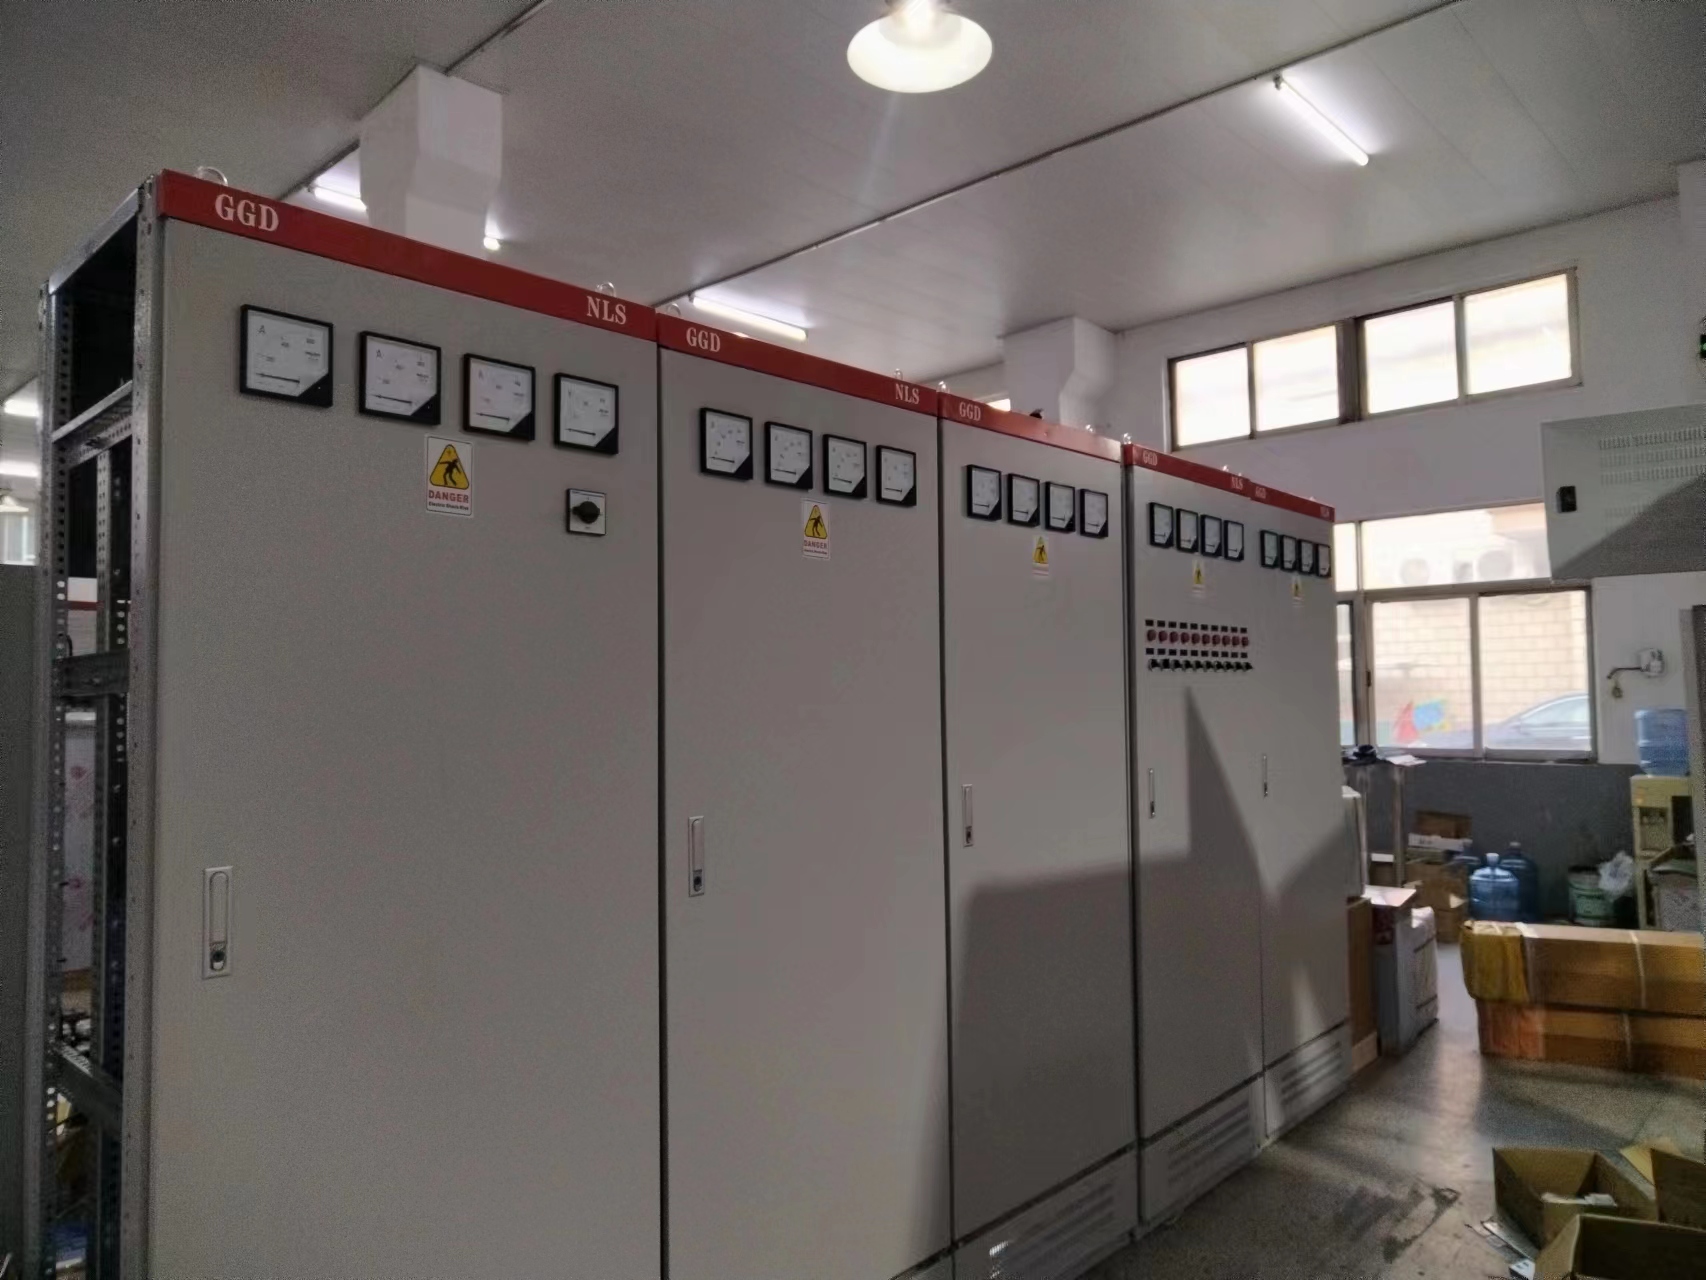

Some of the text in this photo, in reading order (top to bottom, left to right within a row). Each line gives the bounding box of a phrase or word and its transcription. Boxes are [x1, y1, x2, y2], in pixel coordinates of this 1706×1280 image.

[215, 193, 279, 232] GGD
[586, 295, 627, 325] NLS
[686, 327, 721, 353] GGD
[895, 383, 920, 405] NLS
[959, 401, 982, 421] GGD
[428, 489, 469, 504] DANGER
